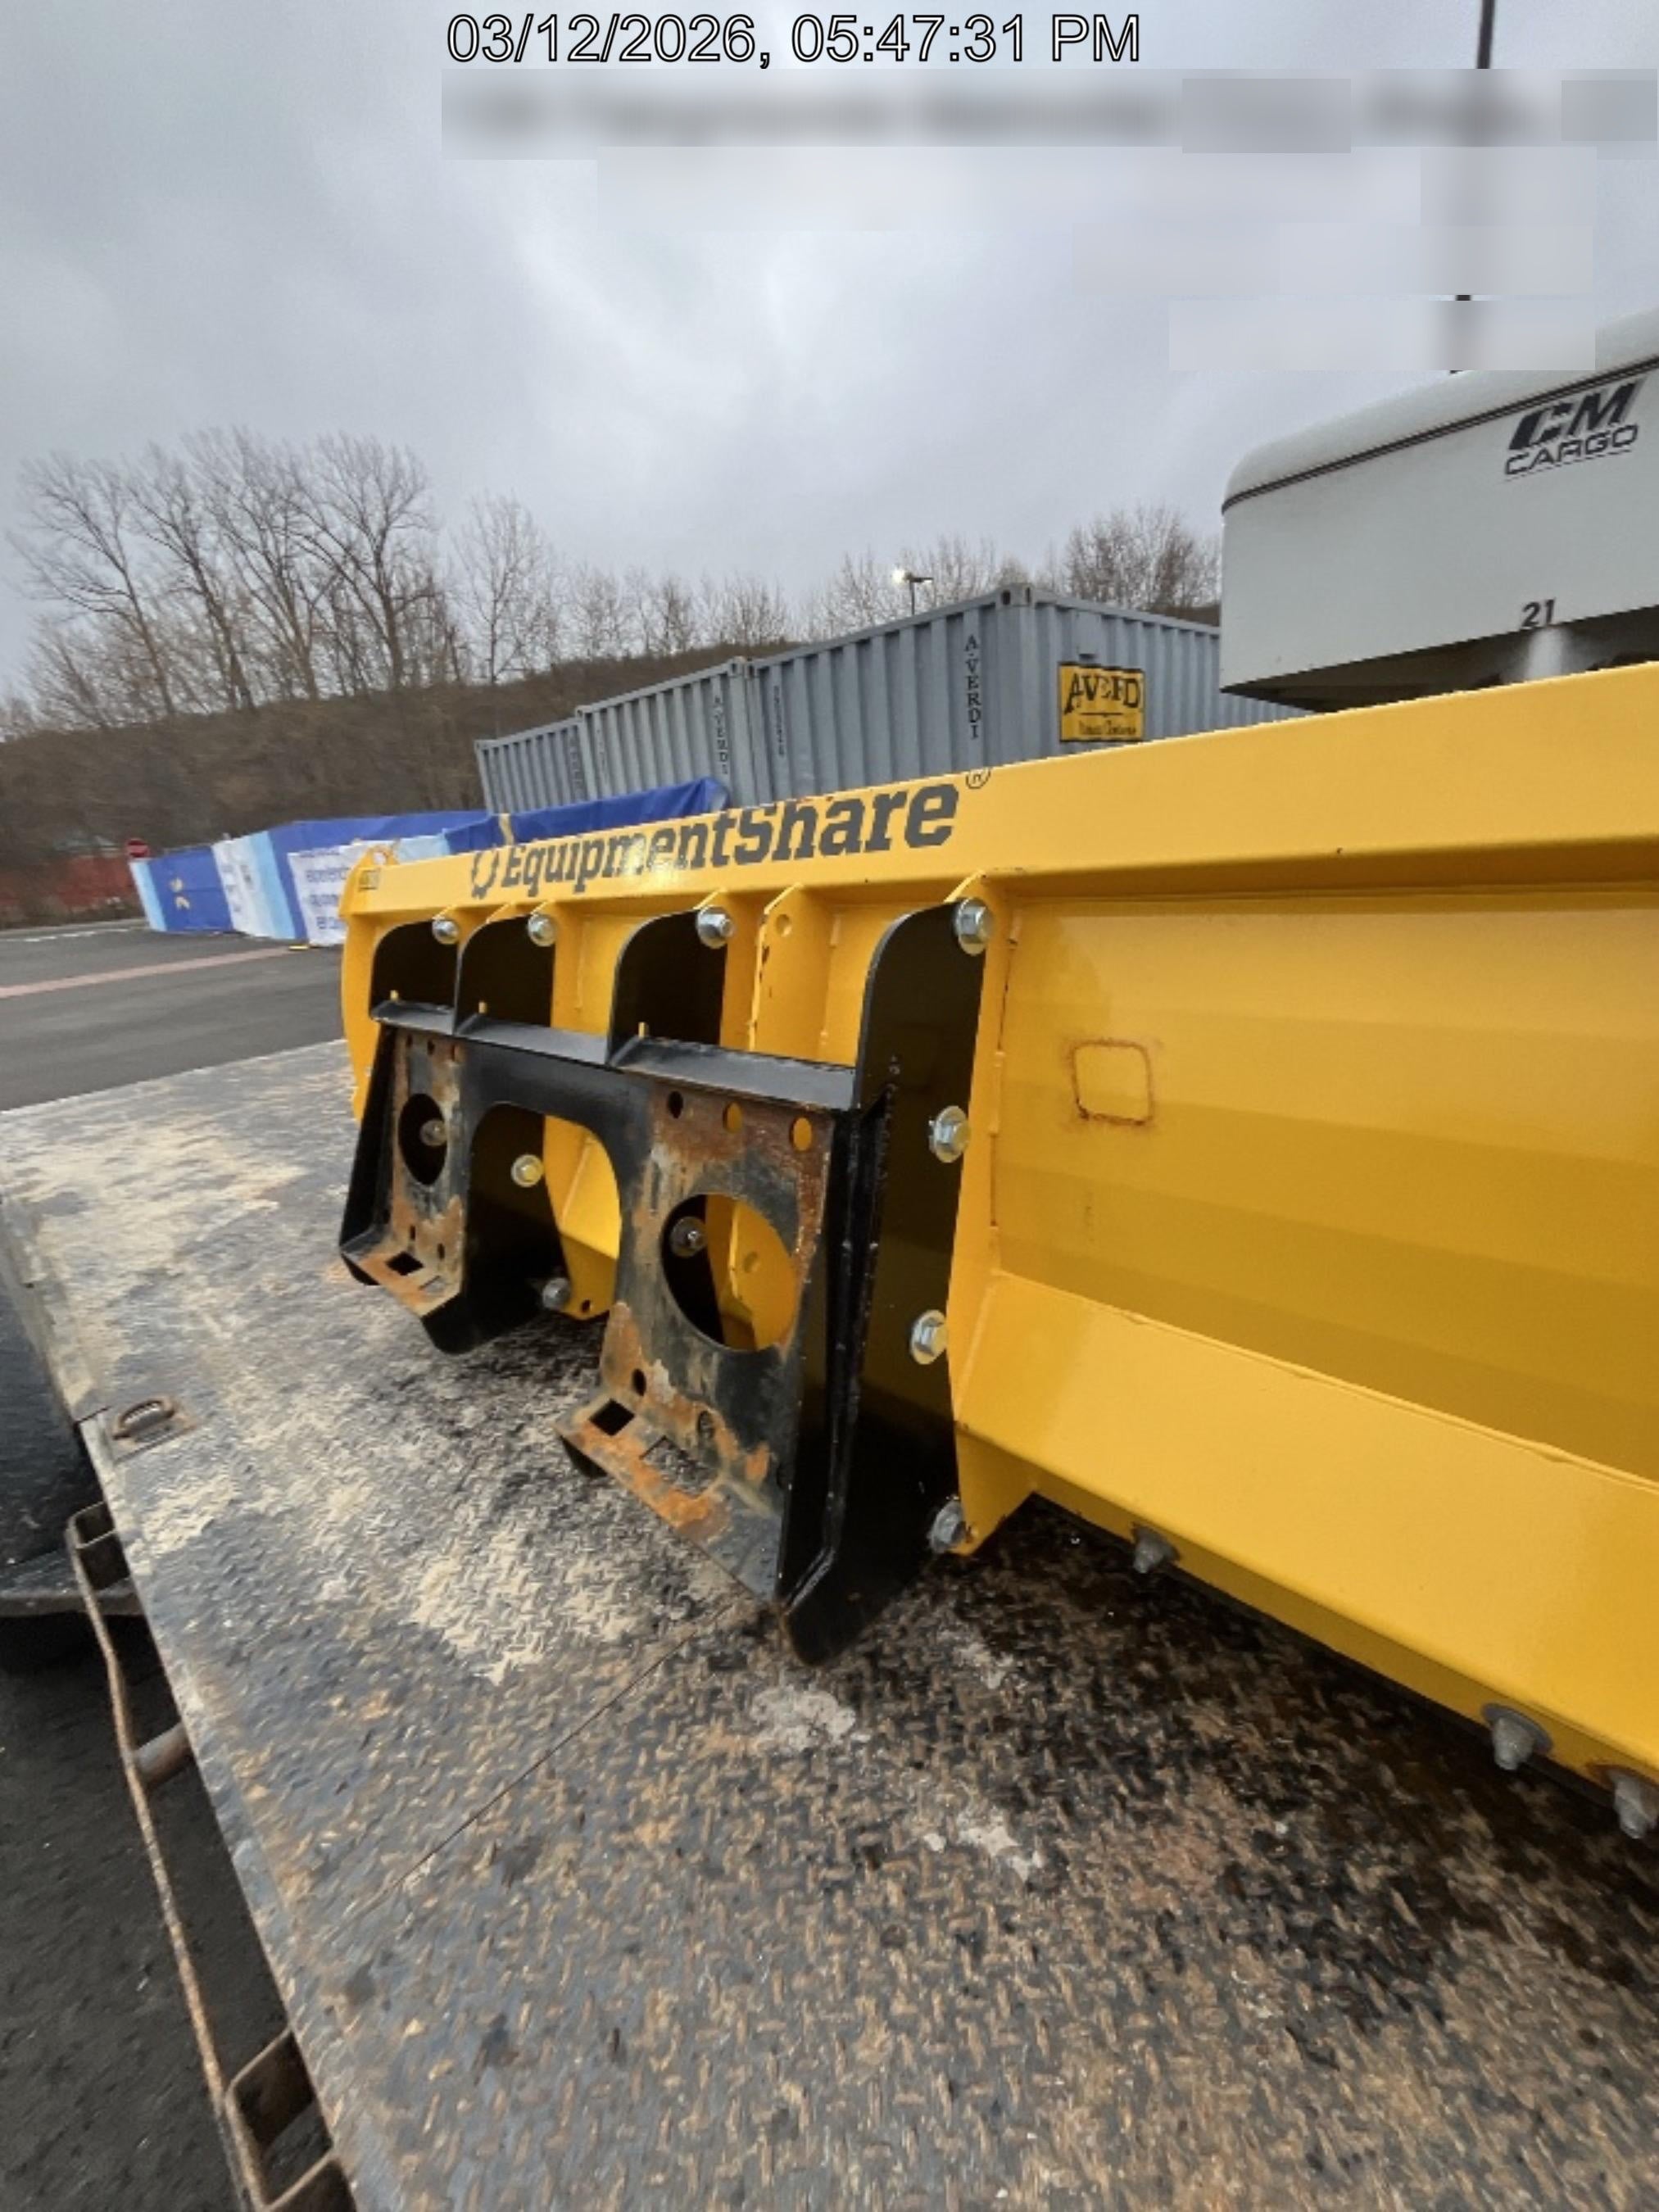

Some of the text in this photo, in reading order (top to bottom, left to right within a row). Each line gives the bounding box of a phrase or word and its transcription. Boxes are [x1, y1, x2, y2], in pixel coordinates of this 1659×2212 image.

[1505, 424, 1639, 475] CARGO
[1508, 382, 1641, 451] CM
[1521, 598, 1556, 628] 21
[965, 634, 981, 740] AVERDI
[501, 783, 959, 898] EquipmentShare
